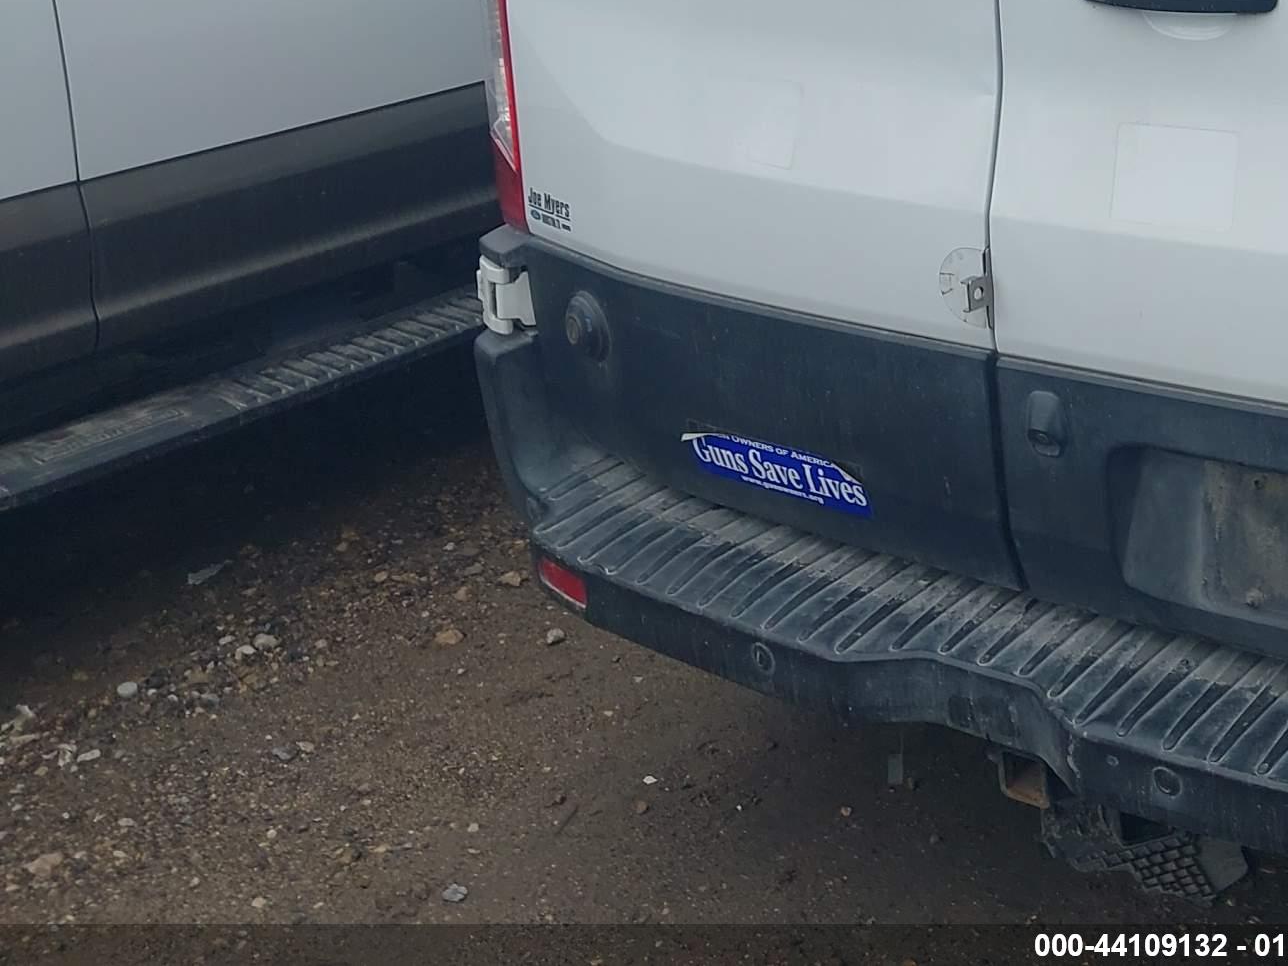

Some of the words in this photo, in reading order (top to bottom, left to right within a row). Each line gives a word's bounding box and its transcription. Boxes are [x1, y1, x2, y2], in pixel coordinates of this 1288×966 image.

[528, 187, 541, 207] Joe
[544, 193, 570, 218] Myers
[692, 436, 748, 474] Guns
[749, 449, 803, 489] Save
[802, 463, 867, 506] Lives
[775, 447, 789, 455] OF
[791, 451, 837, 468] AMERIC
